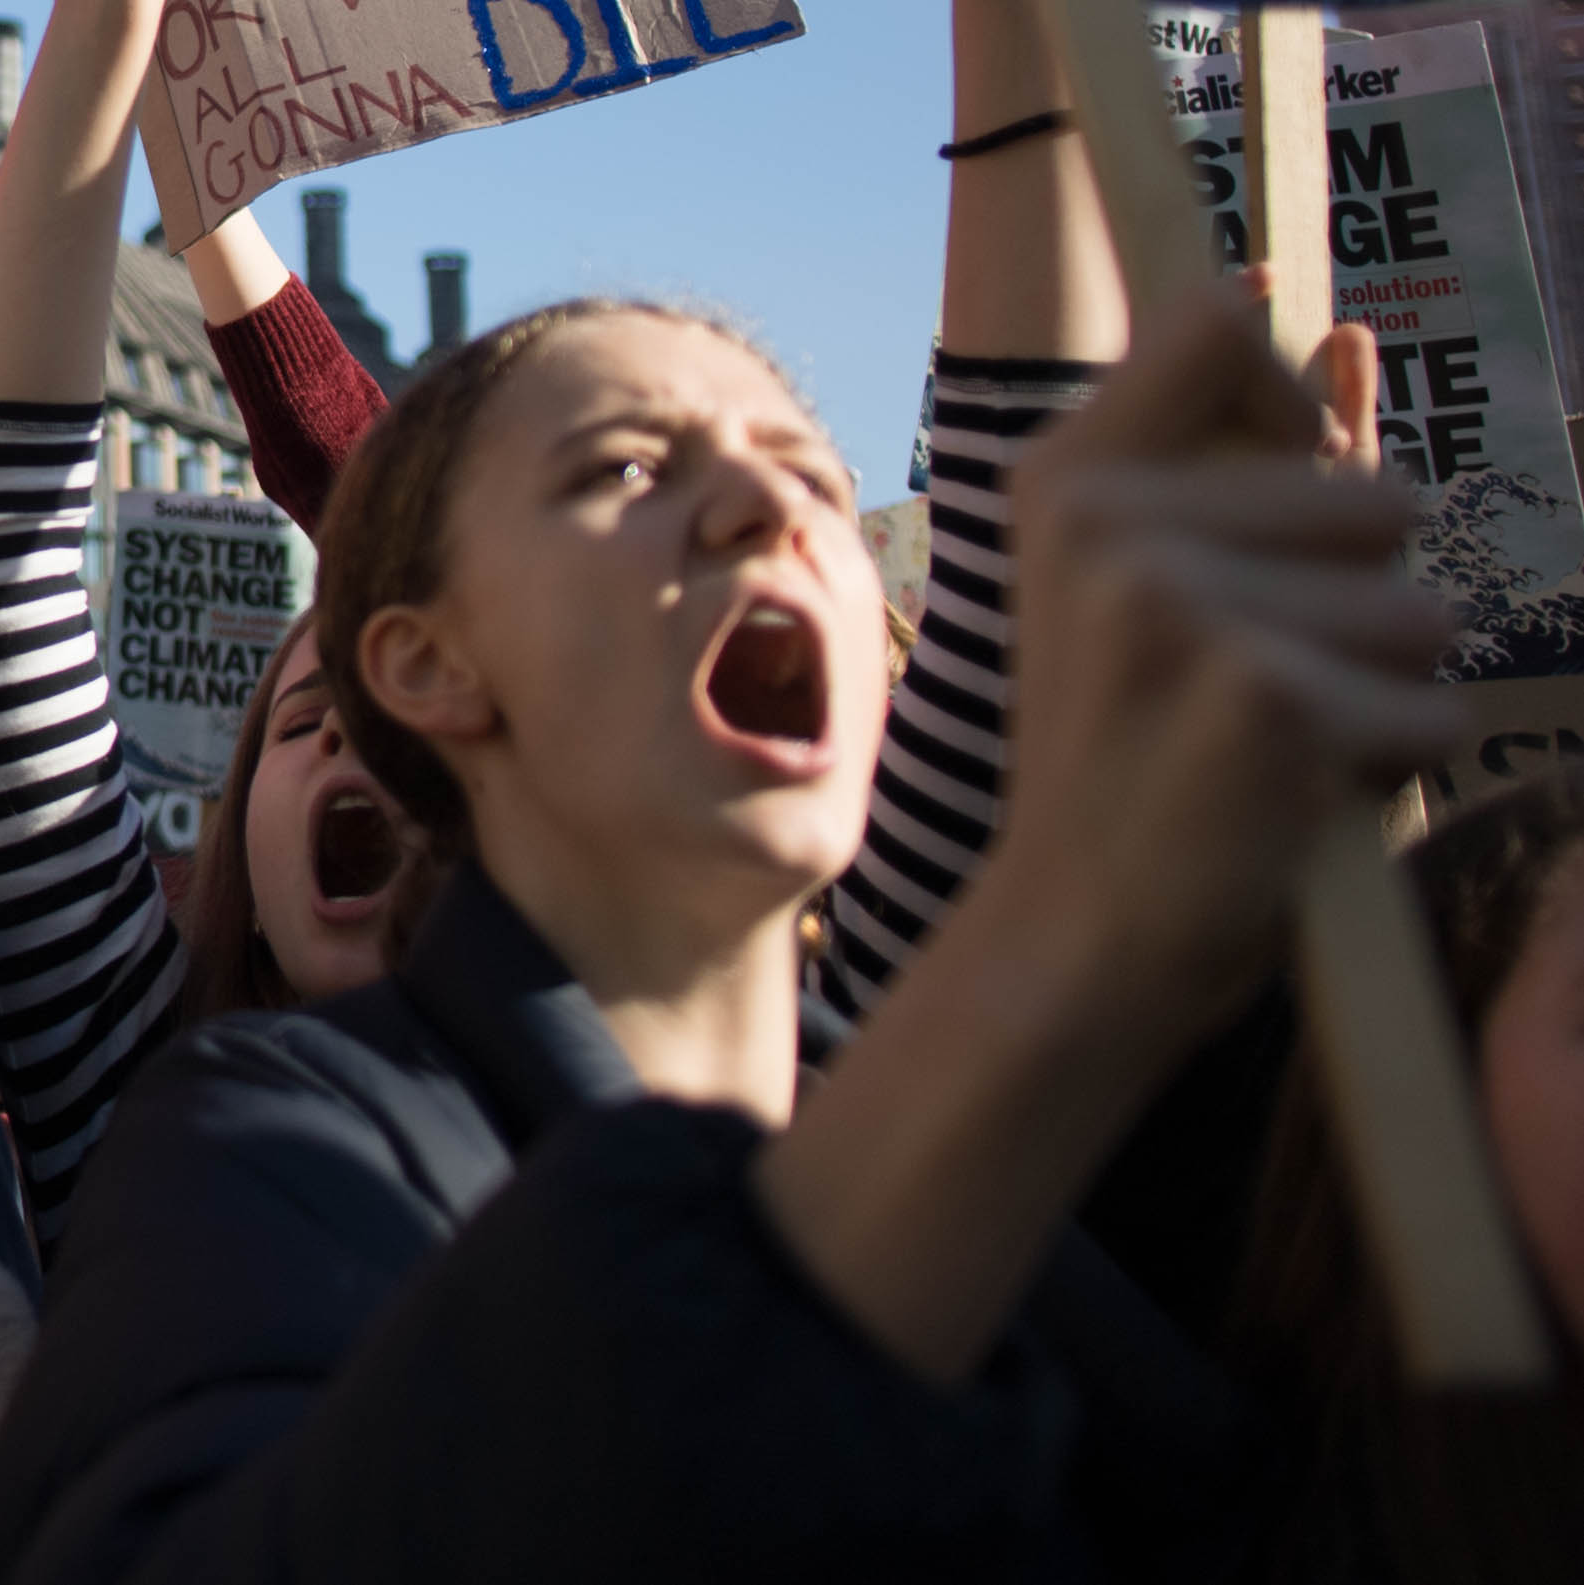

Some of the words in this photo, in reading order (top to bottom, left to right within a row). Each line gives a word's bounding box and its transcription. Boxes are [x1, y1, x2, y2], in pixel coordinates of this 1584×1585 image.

[197, 38, 347, 145] ALL
[204, 63, 475, 206] GONNA
[1339, 274, 1462, 306] solution:
[155, 499, 230, 523] Socialist
[124, 527, 291, 573] SYSTEM
[123, 565, 296, 610] CHANGE
[122, 599, 206, 635] NOT
